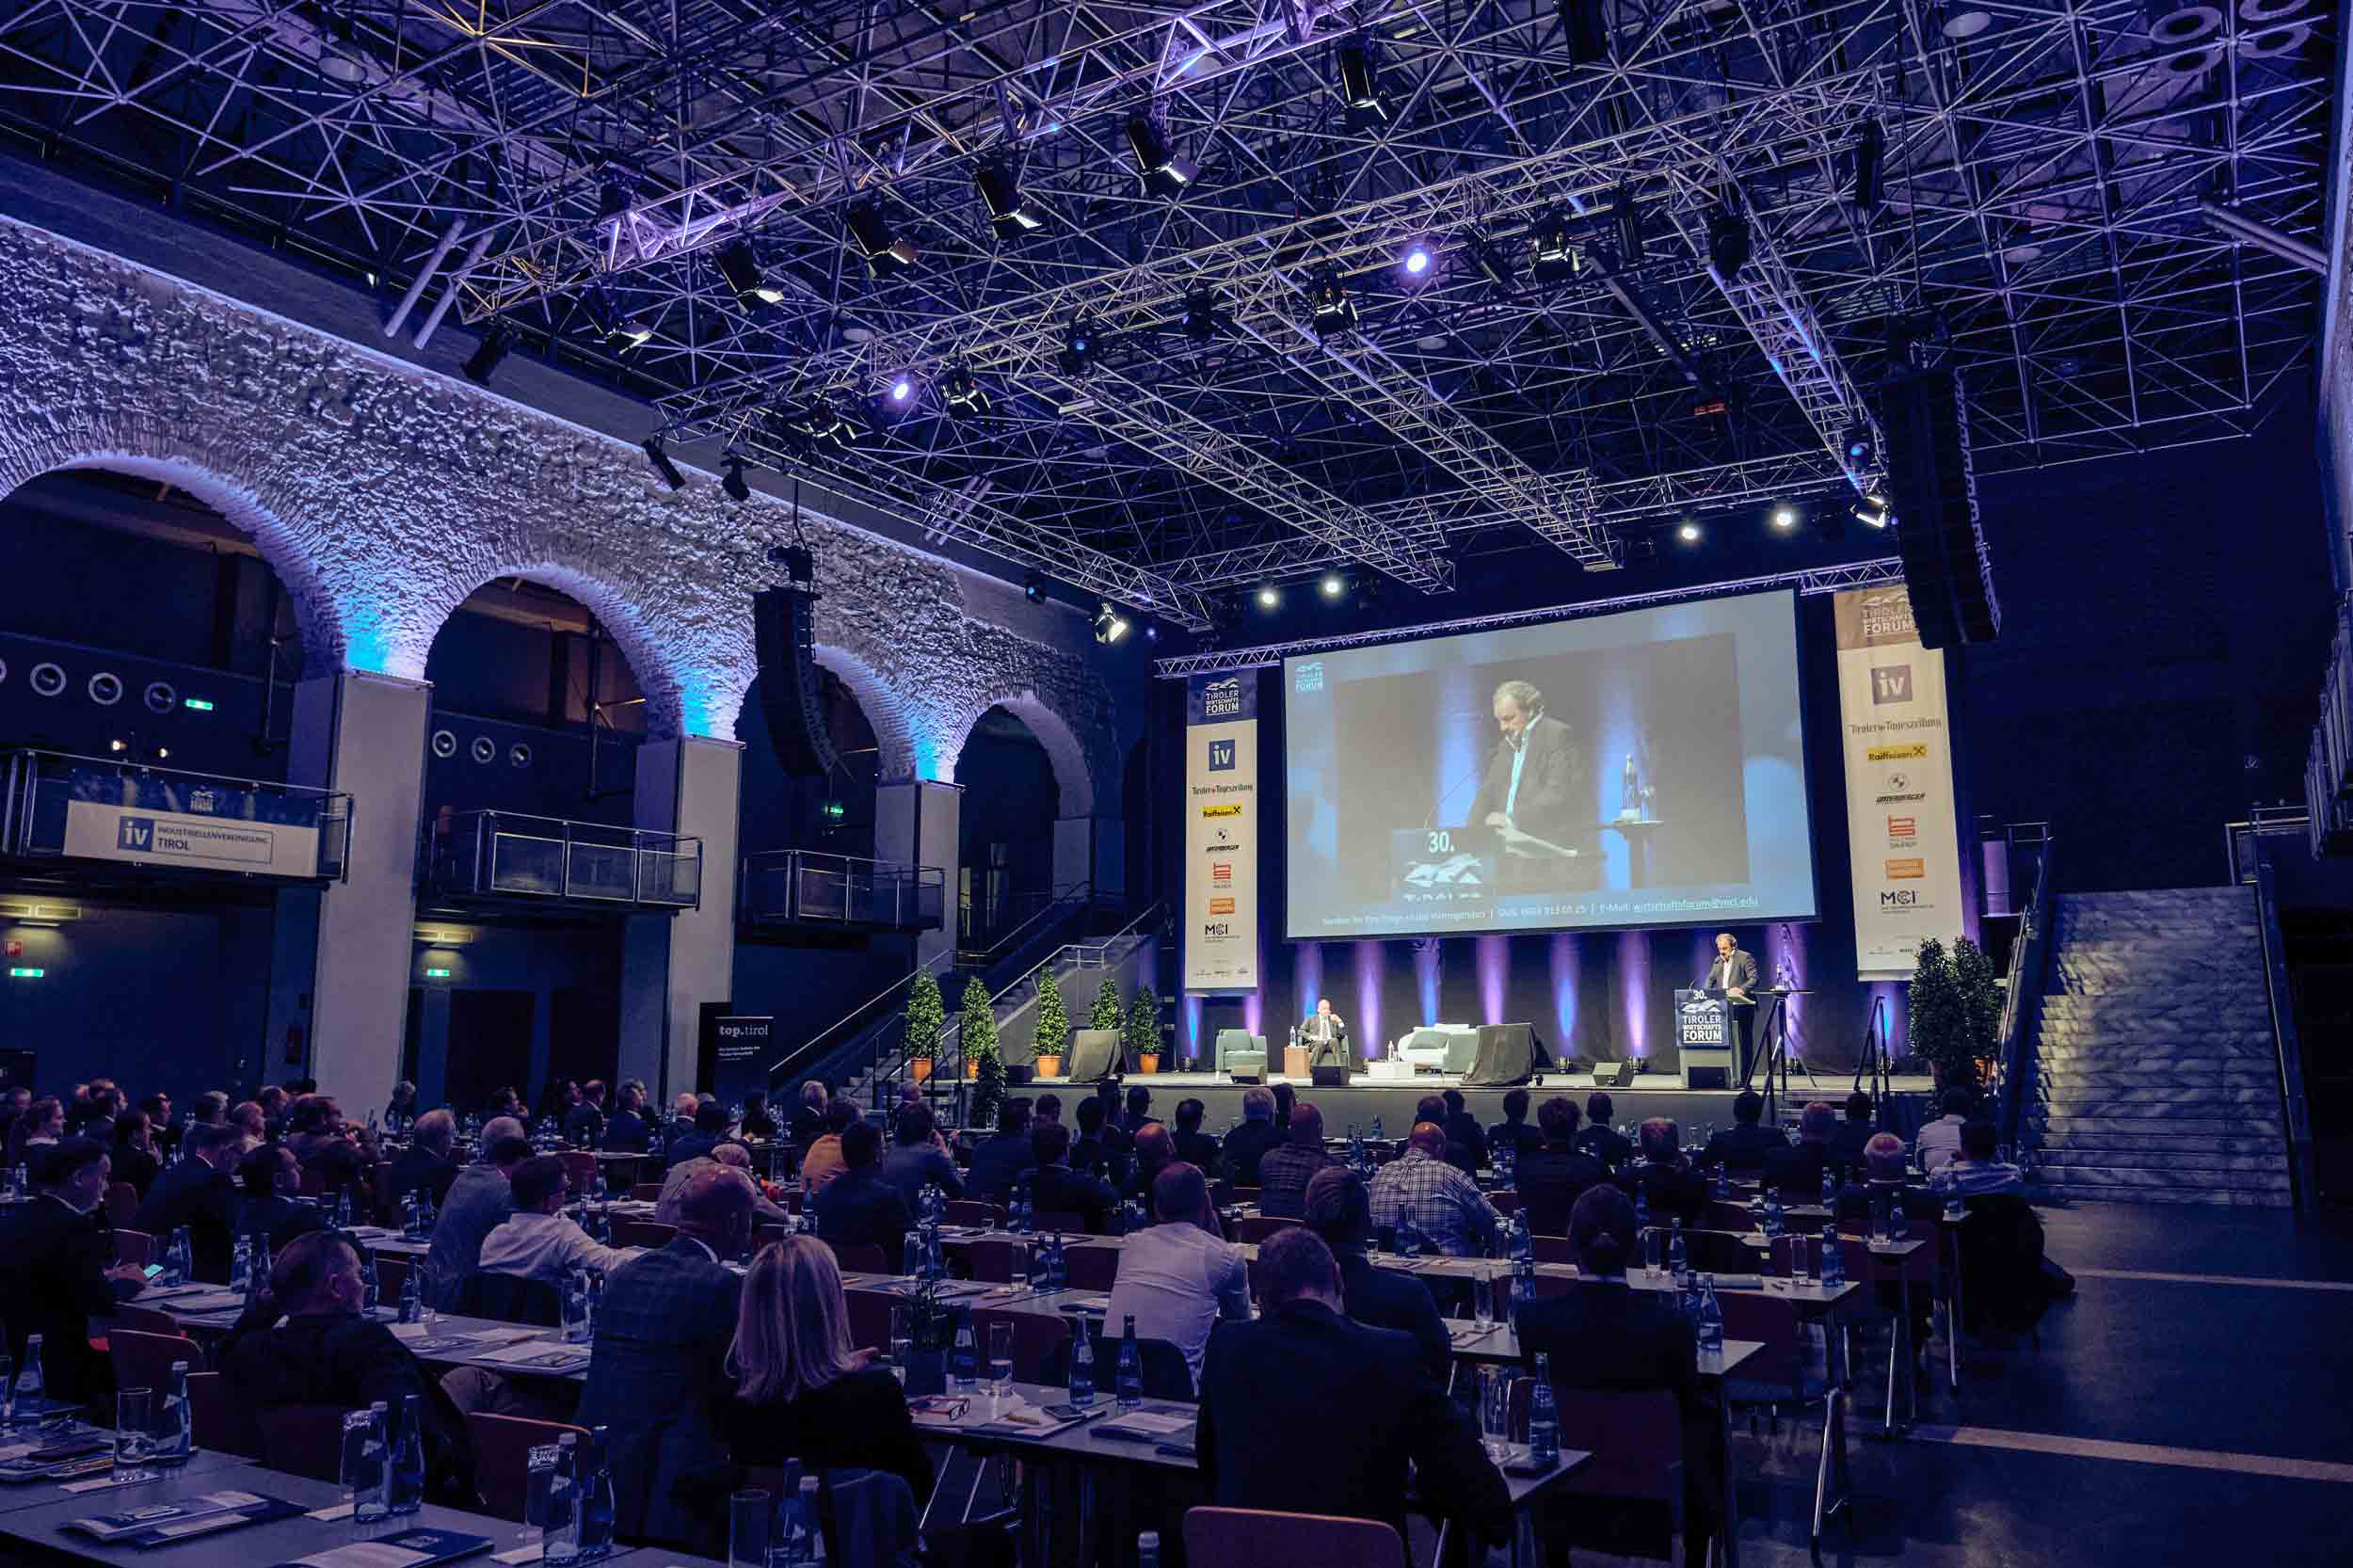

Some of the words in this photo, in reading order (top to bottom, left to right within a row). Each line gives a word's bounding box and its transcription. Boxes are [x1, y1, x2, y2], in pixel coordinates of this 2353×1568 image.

[1864, 620, 1913, 633] FORUM
[1206, 690, 1239, 701] TIROLER
[1206, 702, 1239, 713] FORUM
[158, 837, 191, 851] TIROL
[1428, 831, 1455, 853] 30.
[1881, 889, 1916, 904] MCI
[1205, 923, 1228, 936] MCI
[1693, 989, 1707, 1000] 30.
[1683, 1015, 1721, 1024] TIROLER
[719, 1024, 768, 1038] top.tirol
[1683, 1030, 1722, 1041] FORUM
